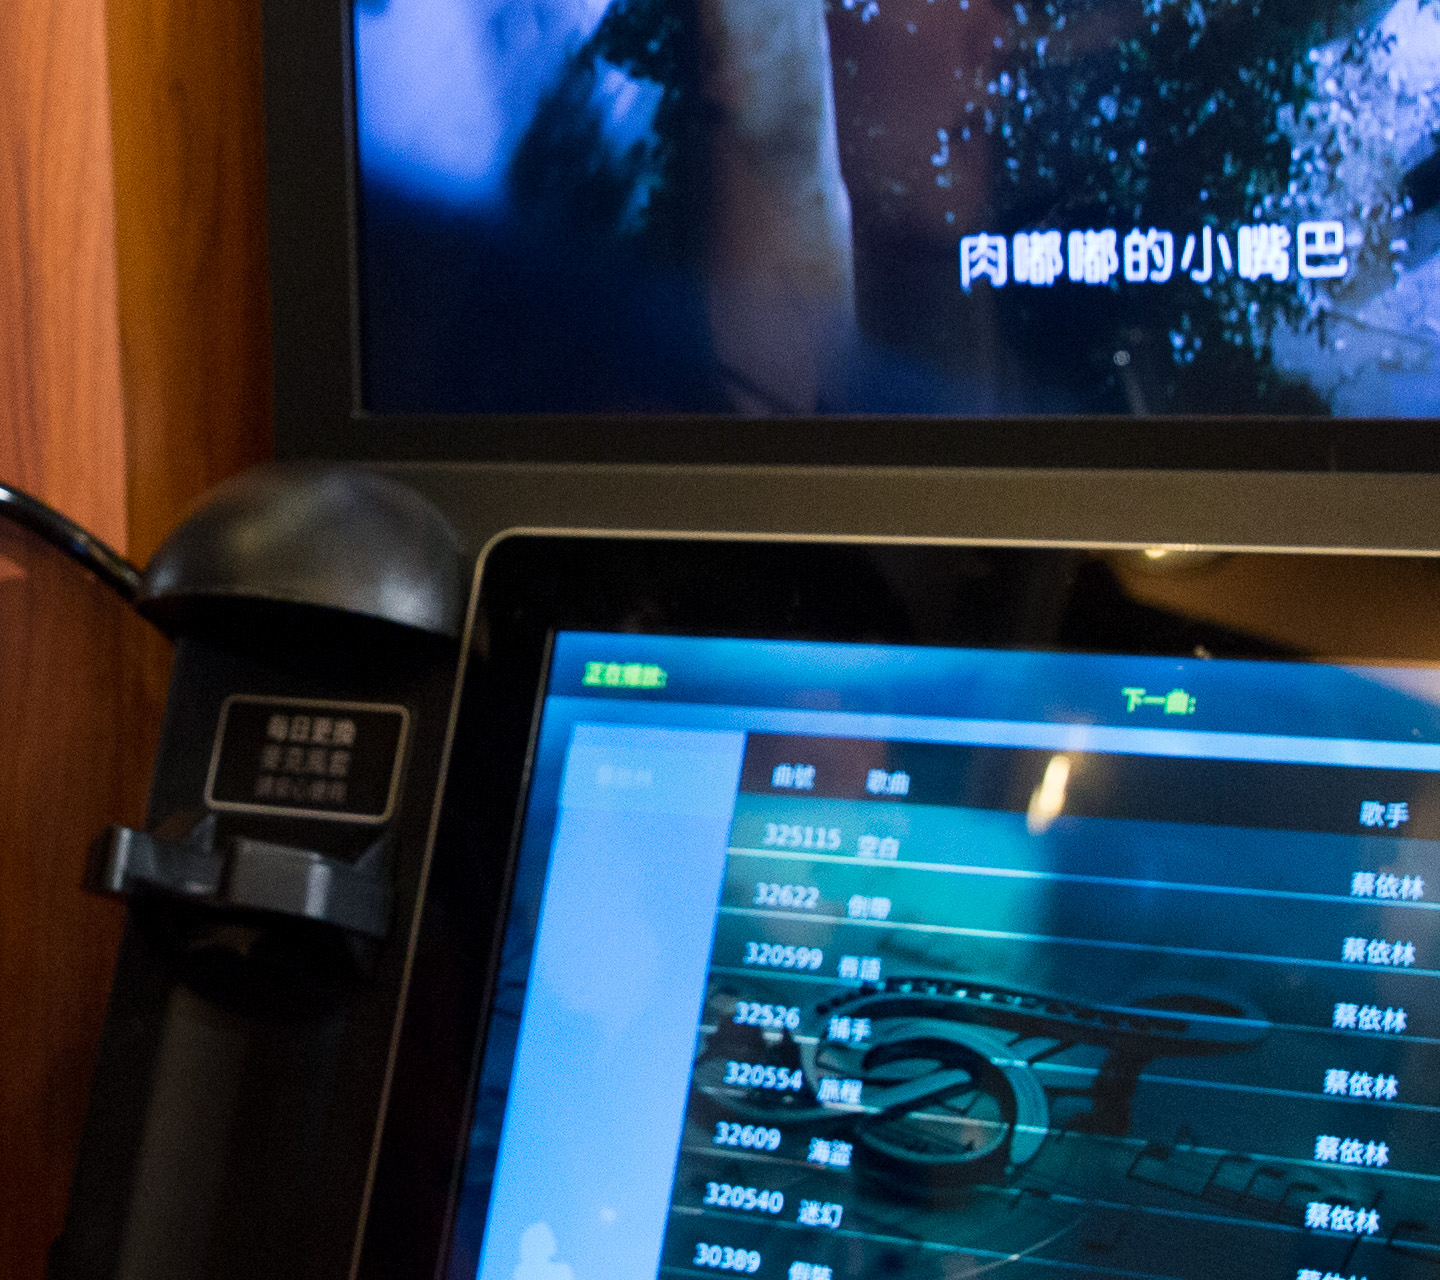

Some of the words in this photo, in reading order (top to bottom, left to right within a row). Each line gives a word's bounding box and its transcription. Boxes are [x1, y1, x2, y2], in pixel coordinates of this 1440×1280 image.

[959, 220, 1349, 294] 肉嘟嘟的小嘴巴
[866, 768, 910, 796] 歌曲
[1358, 799, 1411, 830] 歌手
[763, 822, 842, 850] 325115
[1350, 870, 1425, 904] 蔡依林
[753, 881, 820, 910] 32622
[1342, 936, 1416, 970] 蔡依林
[742, 940, 824, 971] 320599
[1332, 1001, 1408, 1036] 蔡依林
[733, 999, 801, 1031] 32526
[1323, 1067, 1399, 1101] 蔡依林
[723, 1060, 803, 1091] 320554
[1314, 1134, 1389, 1168] 蔡依林
[703, 1181, 784, 1214] 320540
[713, 1121, 781, 1150] 32609
[1304, 1201, 1381, 1235] 蔡依林
[693, 1242, 761, 1273] 30389
